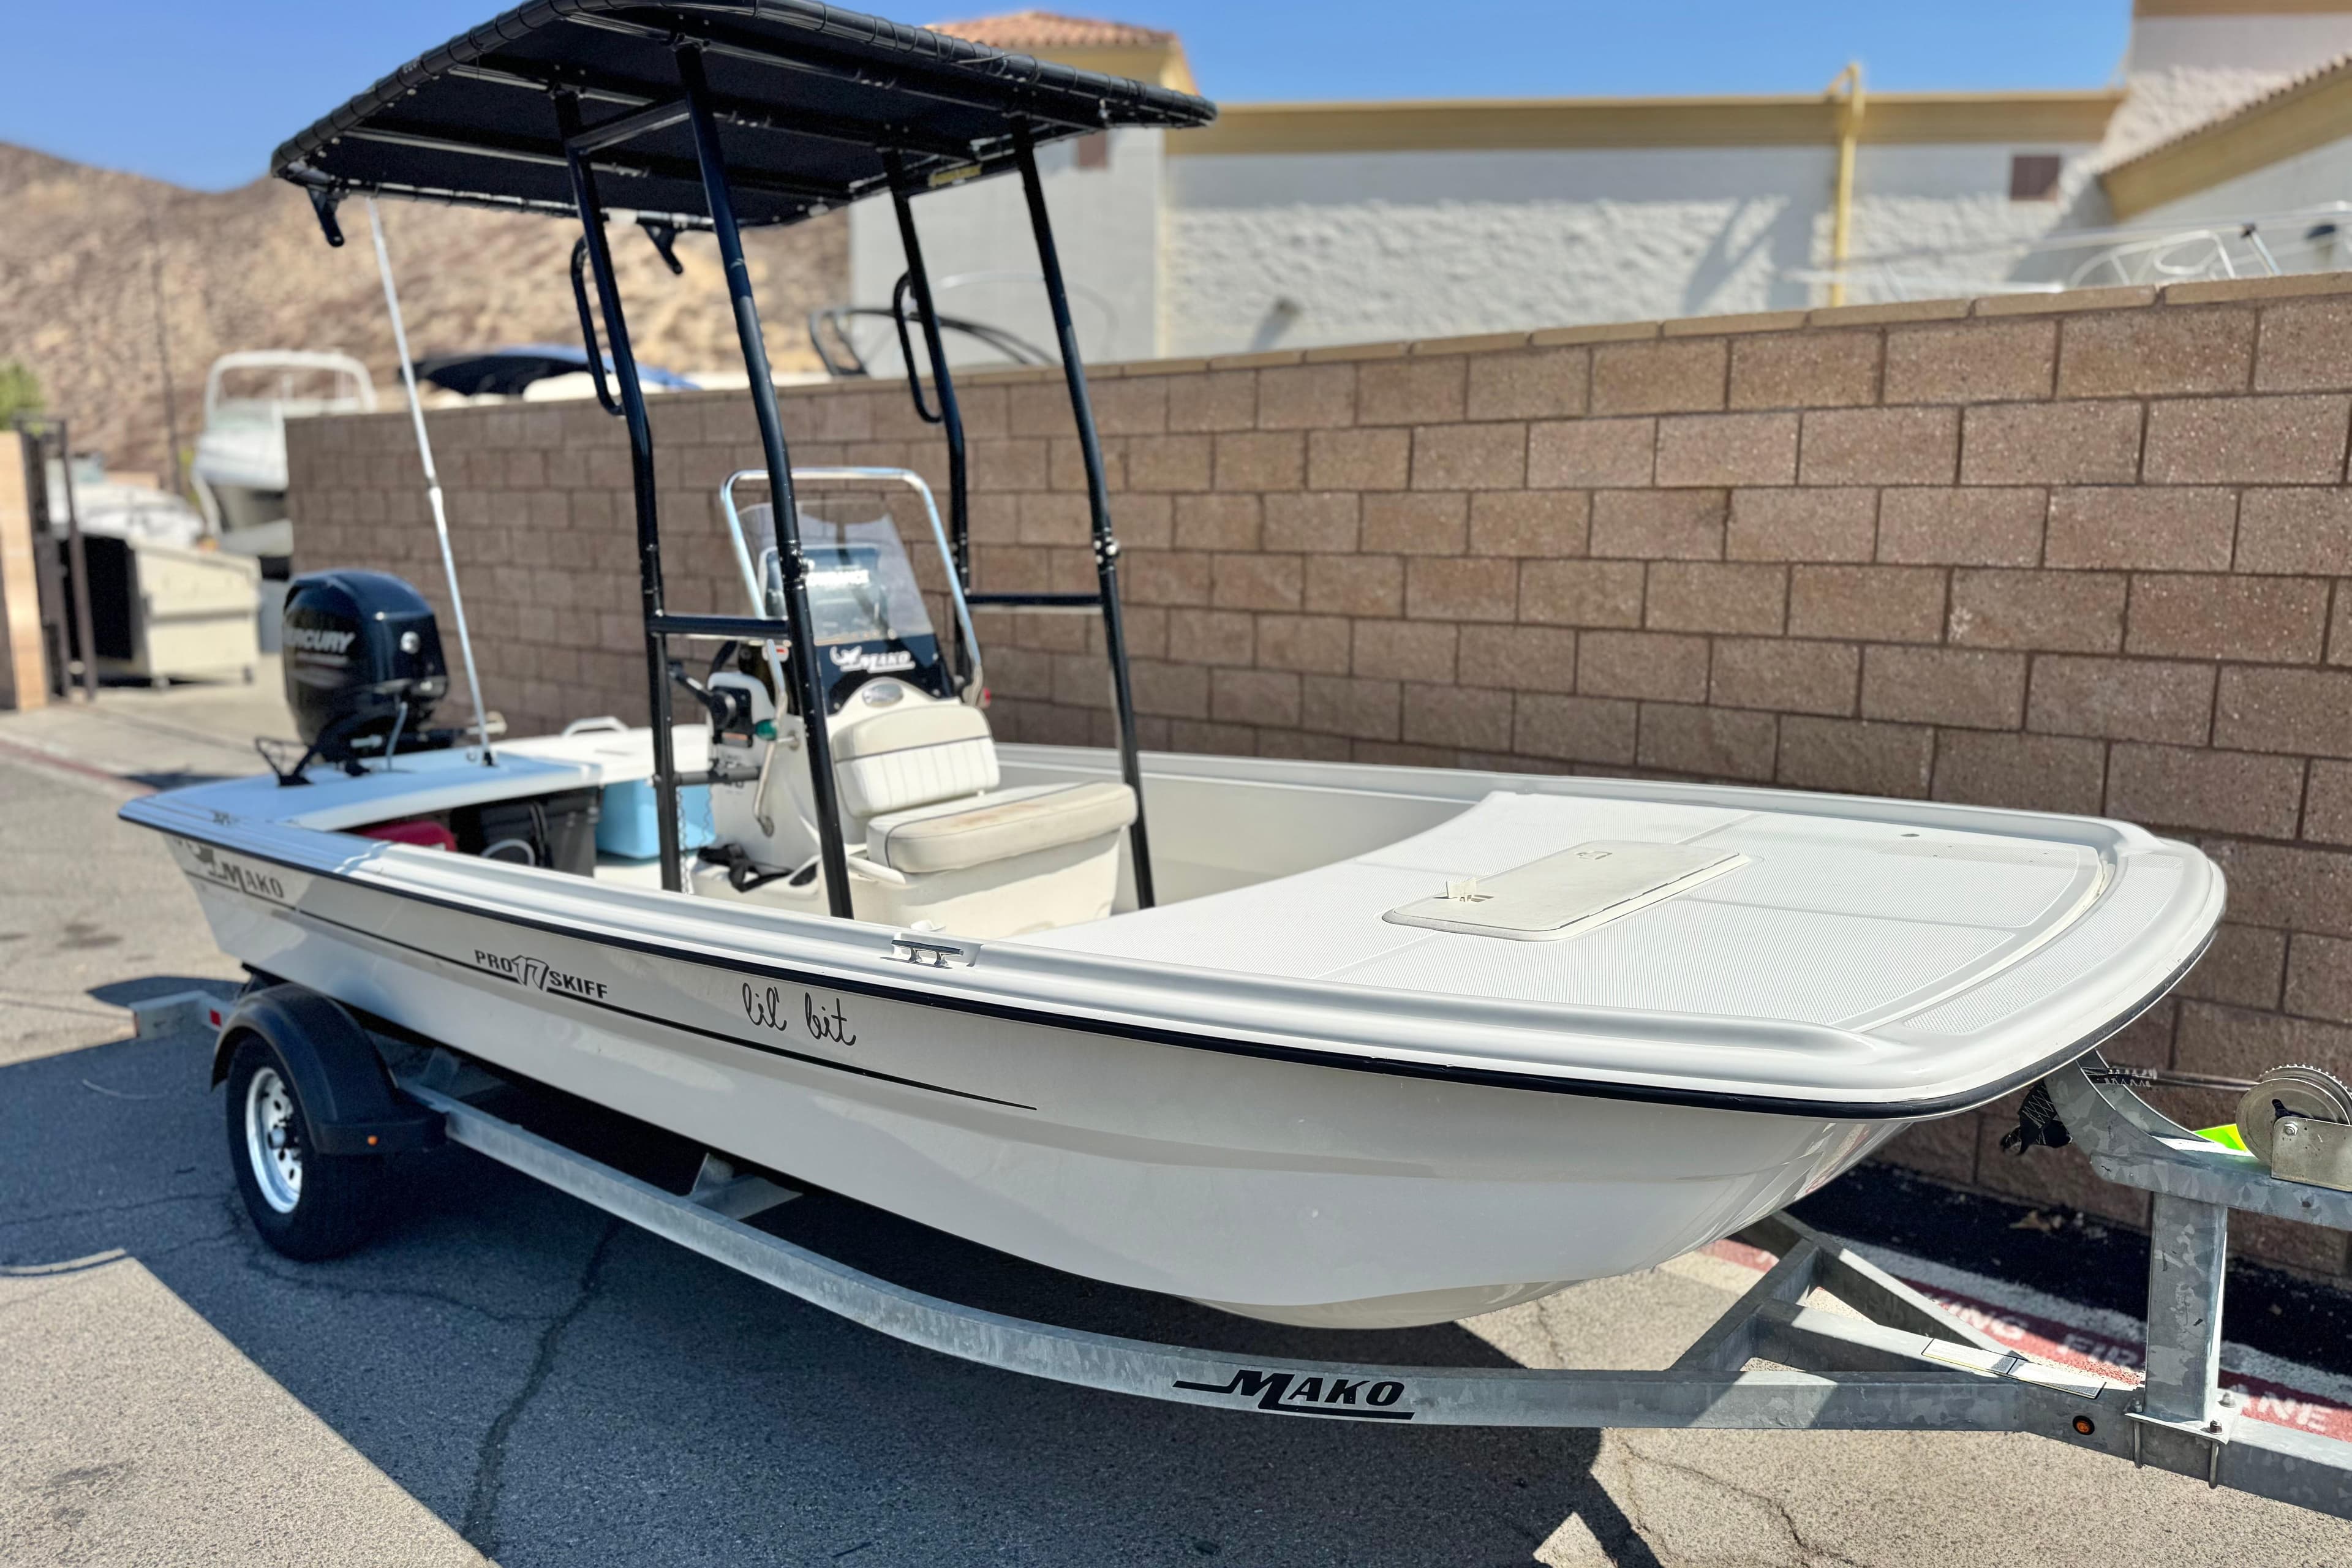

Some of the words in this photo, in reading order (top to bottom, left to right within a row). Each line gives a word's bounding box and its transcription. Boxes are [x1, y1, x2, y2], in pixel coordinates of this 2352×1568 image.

[851, 650, 915, 673] MAKO
[212, 860, 292, 908] MAKO
[473, 949, 512, 973] PRO
[511, 954, 549, 991] 17
[549, 970, 608, 999] SKIFF
[805, 992, 856, 1046] bit
[1172, 1369, 1415, 1420] MAKO
